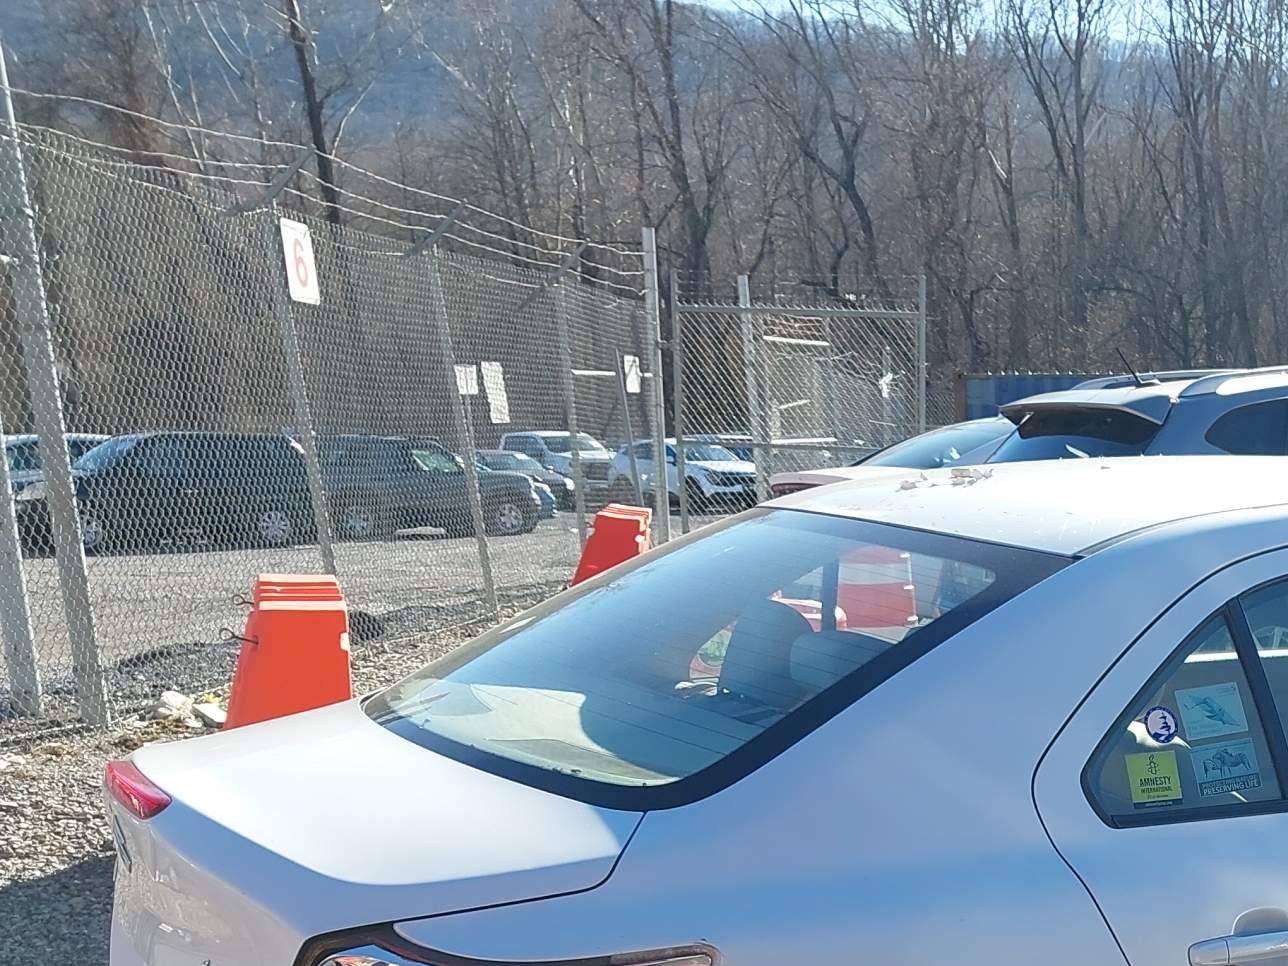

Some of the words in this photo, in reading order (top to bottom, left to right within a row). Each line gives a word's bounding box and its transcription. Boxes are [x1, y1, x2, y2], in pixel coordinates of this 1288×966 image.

[293, 238, 309, 289] 6
[1139, 776, 1172, 788] AMNESTY
[1203, 783, 1245, 796] PRESERVING
